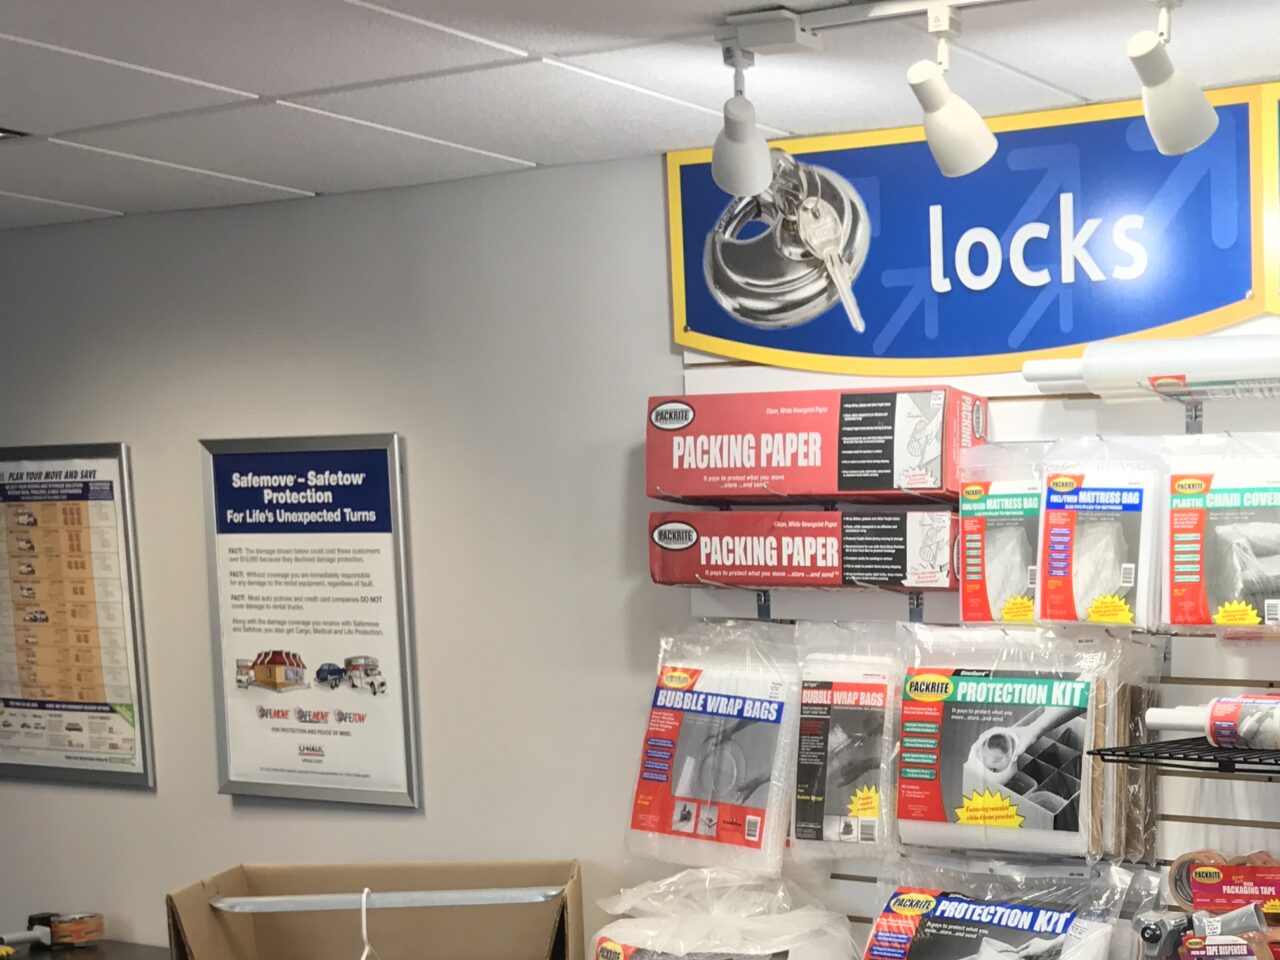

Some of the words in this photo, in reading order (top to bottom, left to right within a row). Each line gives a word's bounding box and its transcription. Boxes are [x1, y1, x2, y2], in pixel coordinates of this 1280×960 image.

[928, 193, 1148, 292] locks
[655, 409, 689, 422] PACKRITE
[673, 433, 756, 469] PACKING
[760, 431, 821, 467] PAPER
[26, 471, 42, 480] YOUR
[44, 471, 62, 479] MOVE
[64, 470, 78, 479] AND
[80, 470, 97, 479] SAVE
[264, 489, 332, 504] Protection
[986, 498, 1021, 510] MATTRESS
[1023, 497, 1038, 509] BAG
[1079, 491, 1119, 505] MATTRESS
[1122, 491, 1139, 504] BAG
[1173, 497, 1203, 508] PLASTIC
[1206, 492, 1241, 507] CHAIR
[1244, 491, 1280, 506] COVER
[227, 510, 243, 523] For
[246, 510, 274, 522] Life's
[277, 509, 341, 525] Unexpected
[344, 508, 376, 522] Turns
[658, 530, 692, 542] PACKRITE
[701, 536, 777, 566] PACKING
[782, 537, 838, 567] PAPER
[909, 680, 949, 694] PACKRITE
[958, 682, 1048, 705] PROTECTION
[1052, 682, 1084, 706] KIT
[656, 689, 704, 711] BUBBLE
[707, 695, 743, 716] WRAP
[744, 701, 778, 721] BAGS
[802, 690, 831, 704] BUBBLE
[833, 691, 858, 705] WRAP
[860, 692, 883, 706] BAGS
[1194, 871, 1220, 880] PACKRITE
[1223, 885, 1259, 895] PACKAGING
[1260, 886, 1276, 895] TAPE
[893, 897, 933, 910] PACKRITE
[935, 900, 1032, 929] PROTECTION
[1034, 910, 1069, 934] KIT
[1206, 946, 1219, 955] TAPE
[1219, 945, 1248, 955] DISPENSER
